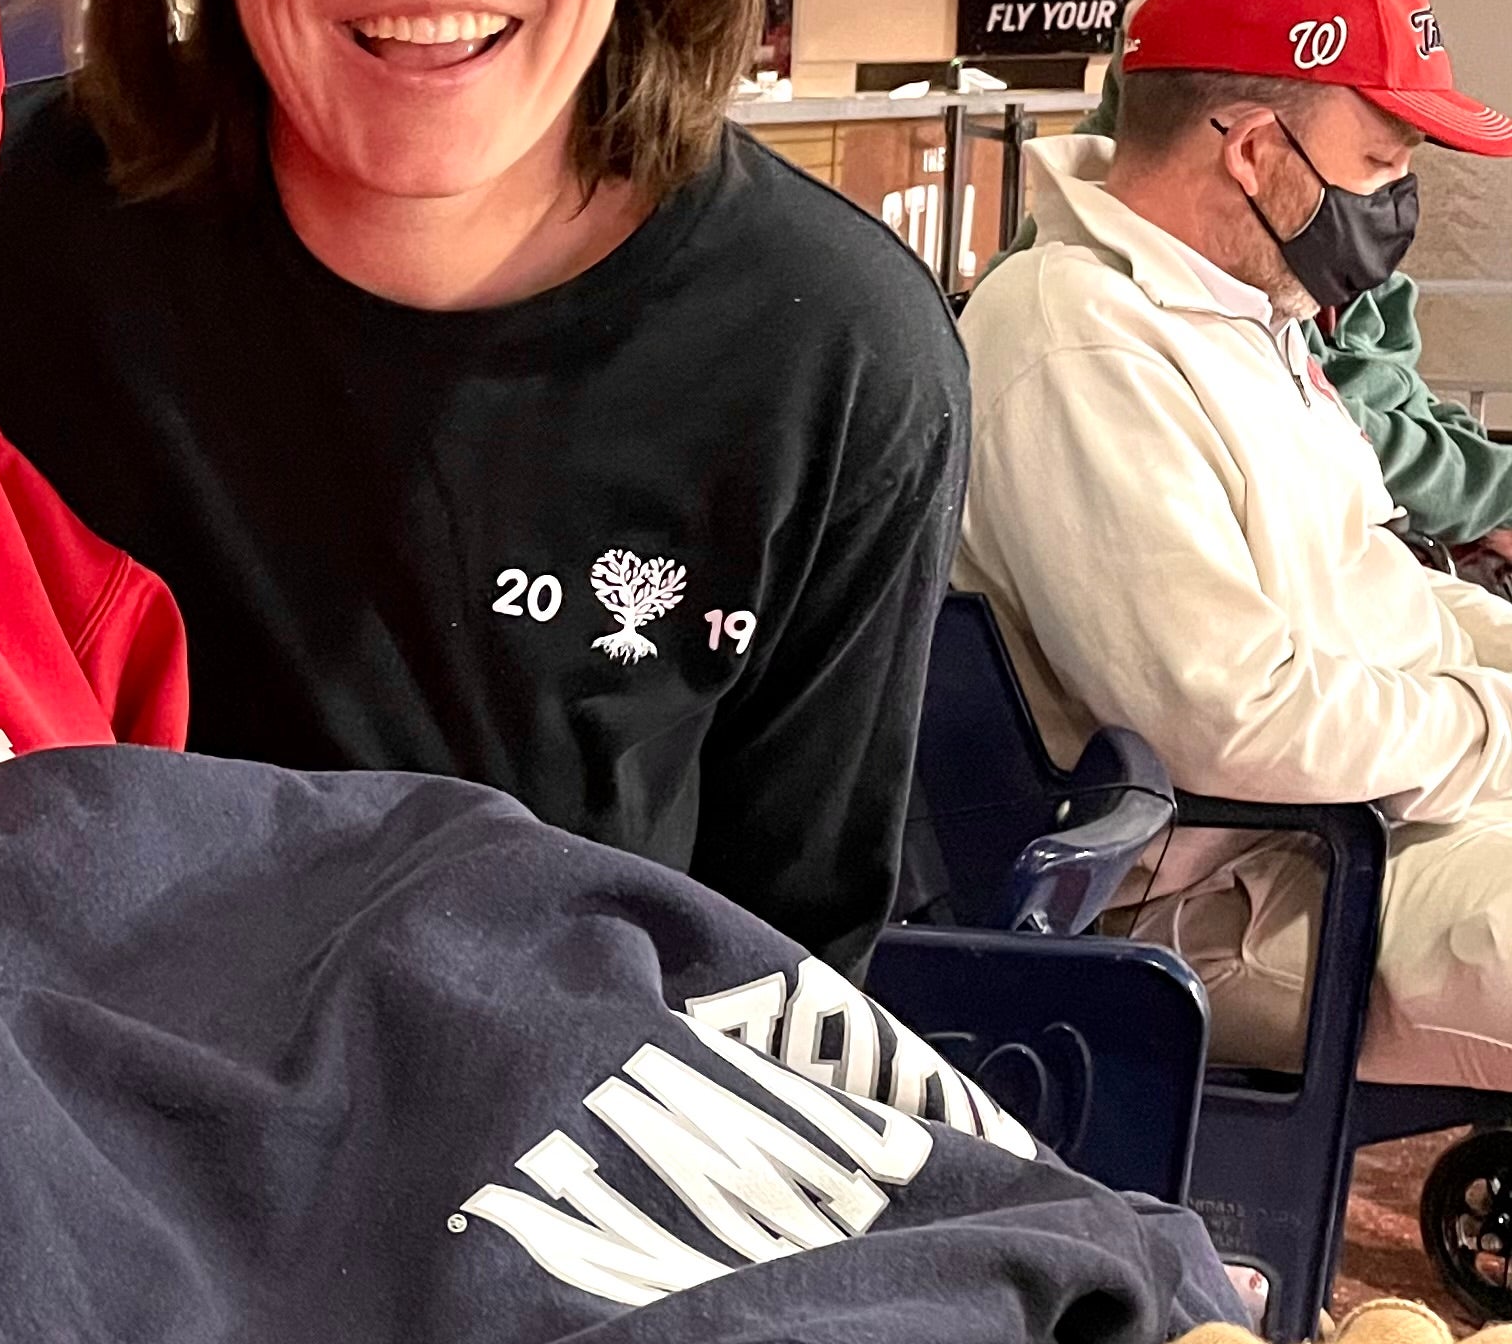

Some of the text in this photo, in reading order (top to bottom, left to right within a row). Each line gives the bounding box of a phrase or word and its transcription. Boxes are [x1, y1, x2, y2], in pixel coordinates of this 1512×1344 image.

[986, 0, 1118, 33] FLY YOUR
[1289, 15, 1347, 70] W
[492, 568, 563, 622] 20
[704, 608, 757, 655] 19
